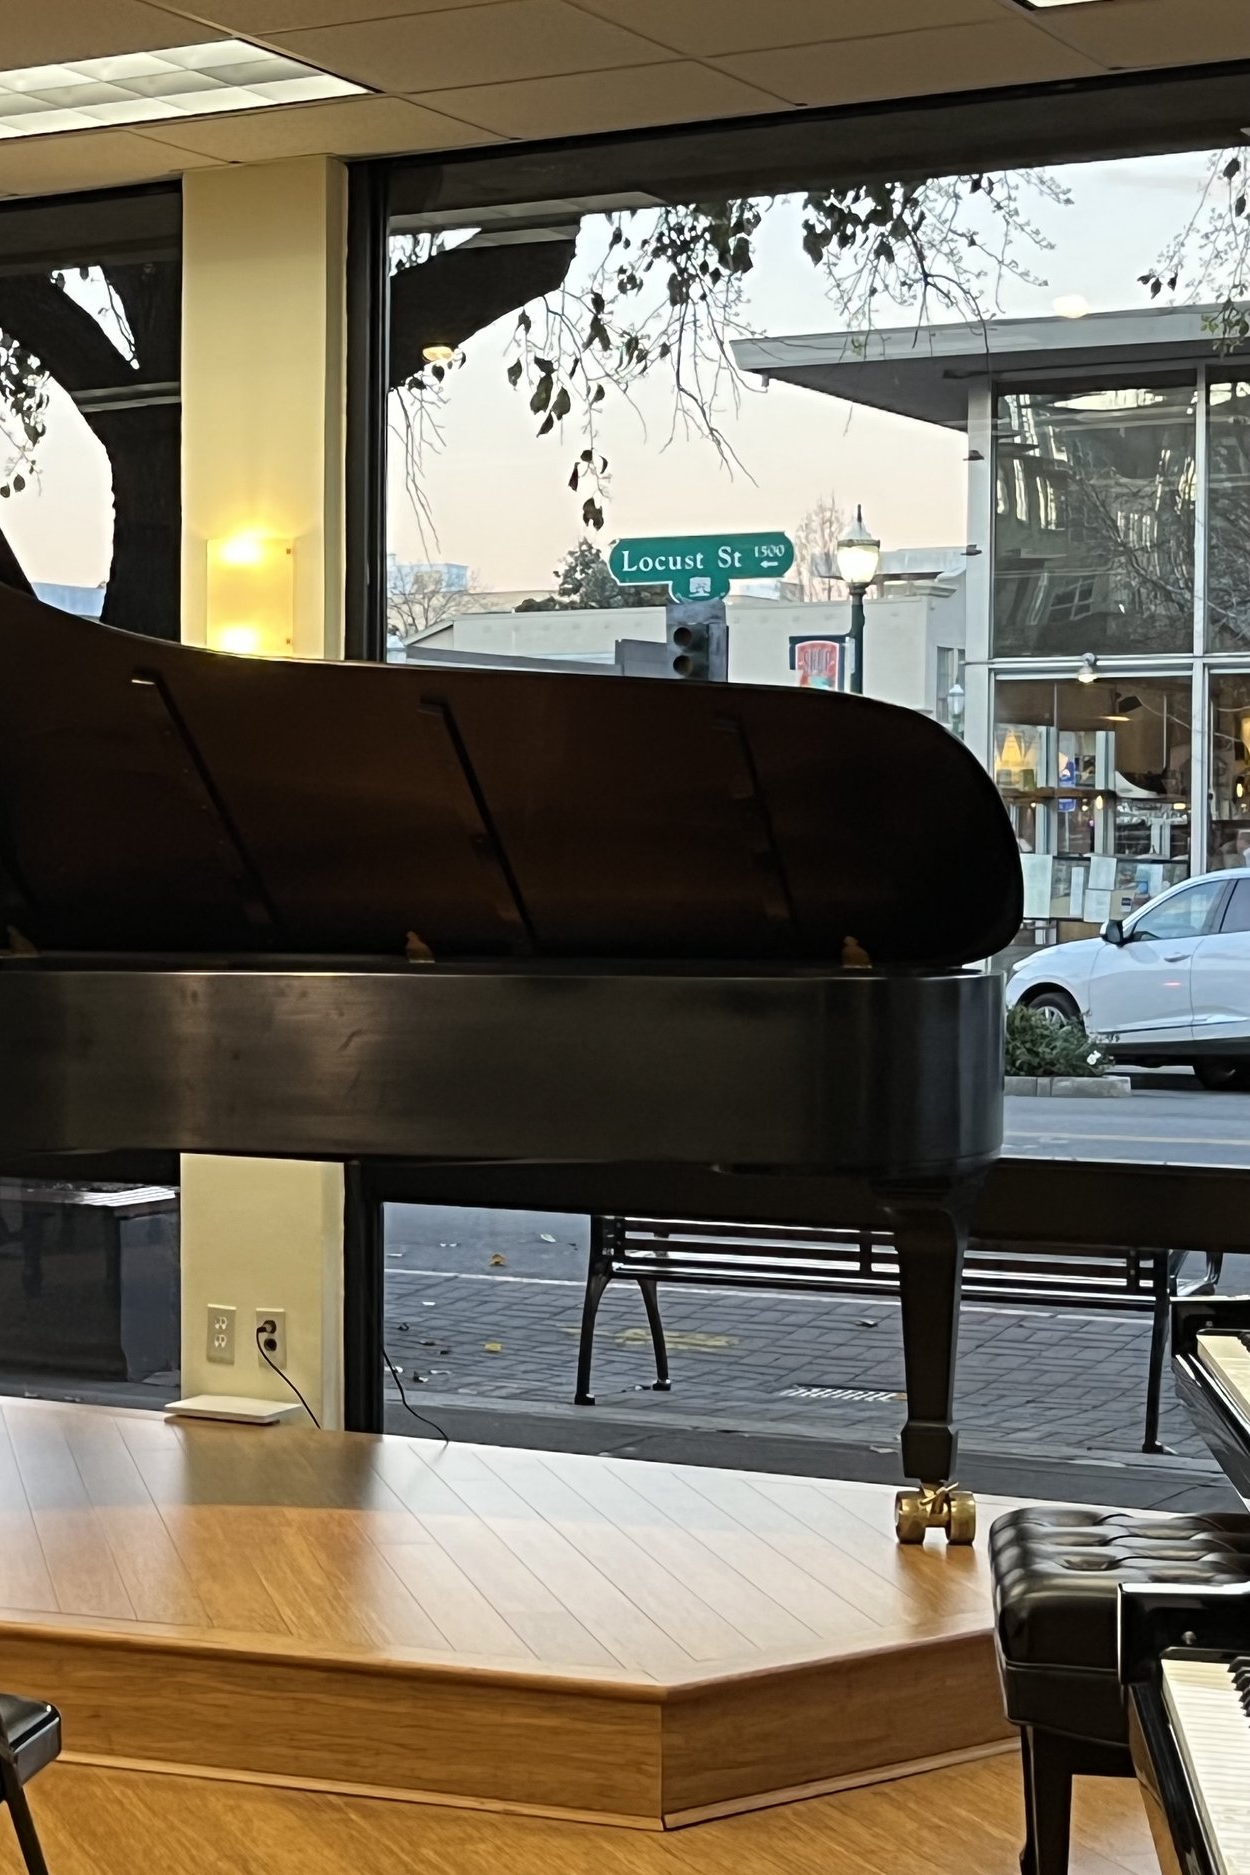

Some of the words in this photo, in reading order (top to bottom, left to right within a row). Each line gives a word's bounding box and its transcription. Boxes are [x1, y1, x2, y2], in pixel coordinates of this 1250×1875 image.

[622, 550, 704, 572] Locust
[718, 545, 743, 569] St
[754, 544, 786, 558] 1500
